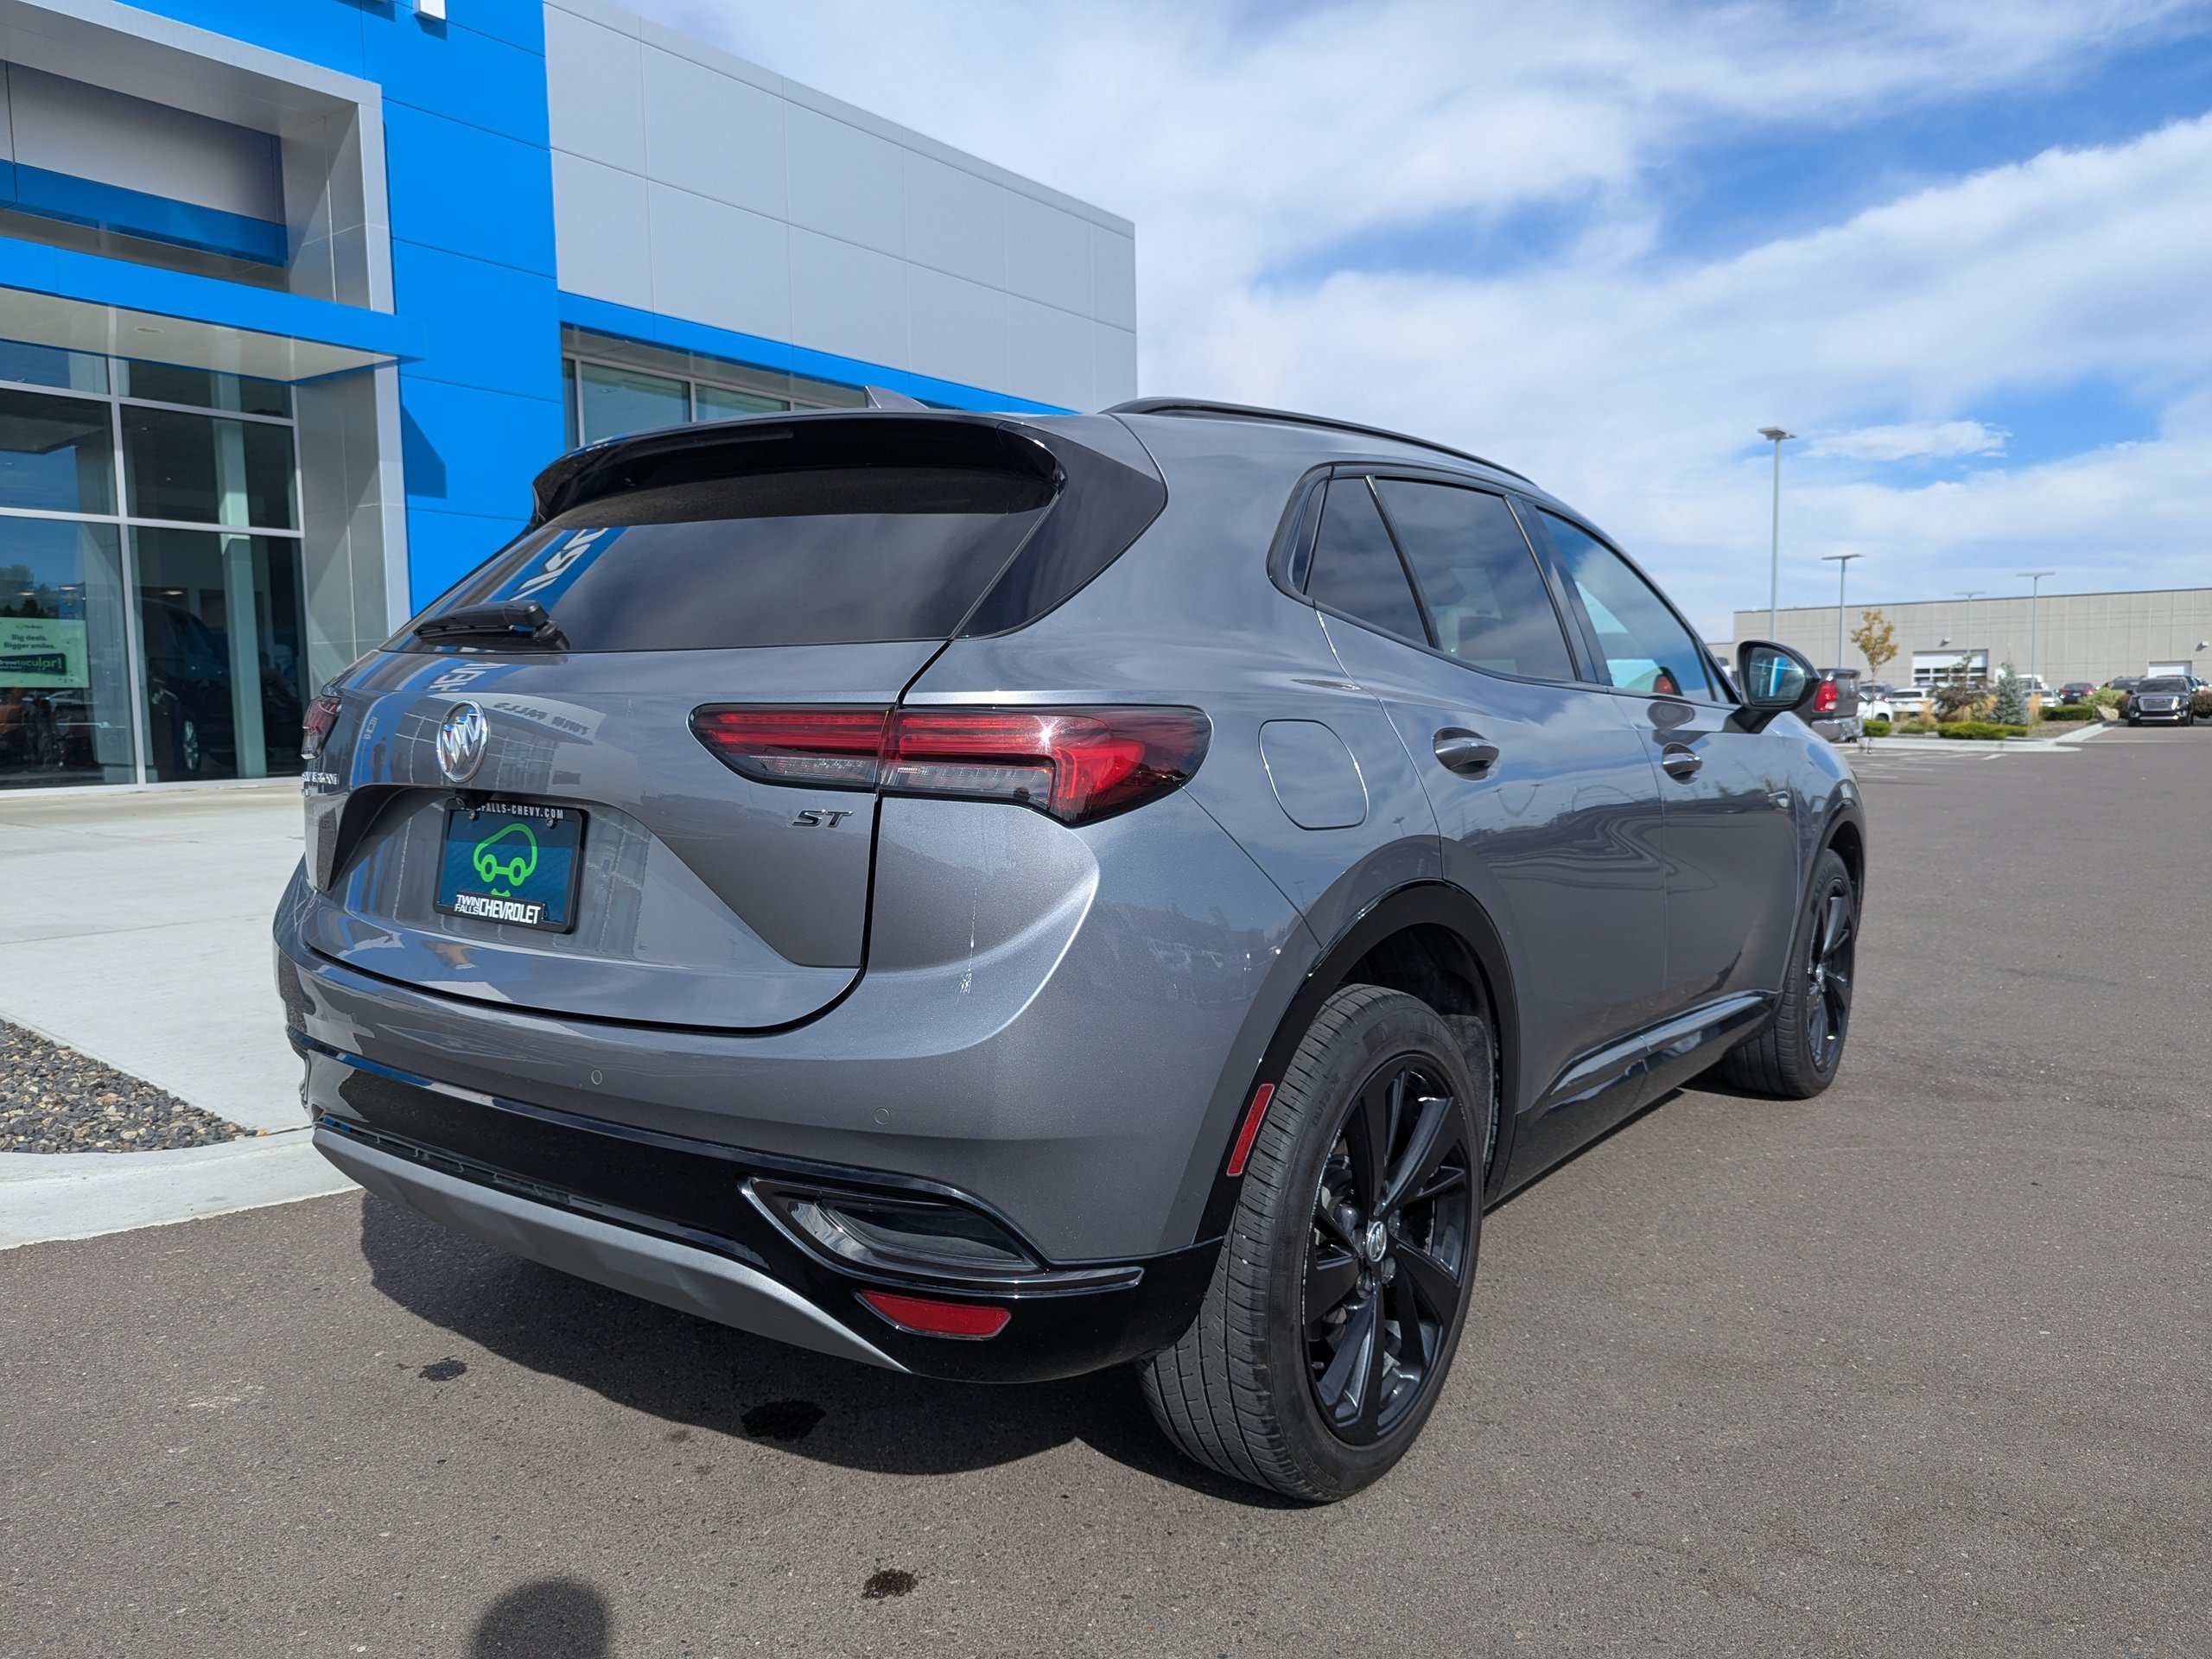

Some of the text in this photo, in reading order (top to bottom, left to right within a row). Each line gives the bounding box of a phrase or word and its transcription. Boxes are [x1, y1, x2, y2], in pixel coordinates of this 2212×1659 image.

[792, 809, 855, 829] ST
[456, 894, 480, 907] TWIN
[454, 904, 480, 916] FALLS
[479, 898, 542, 925] CHEVROLET
